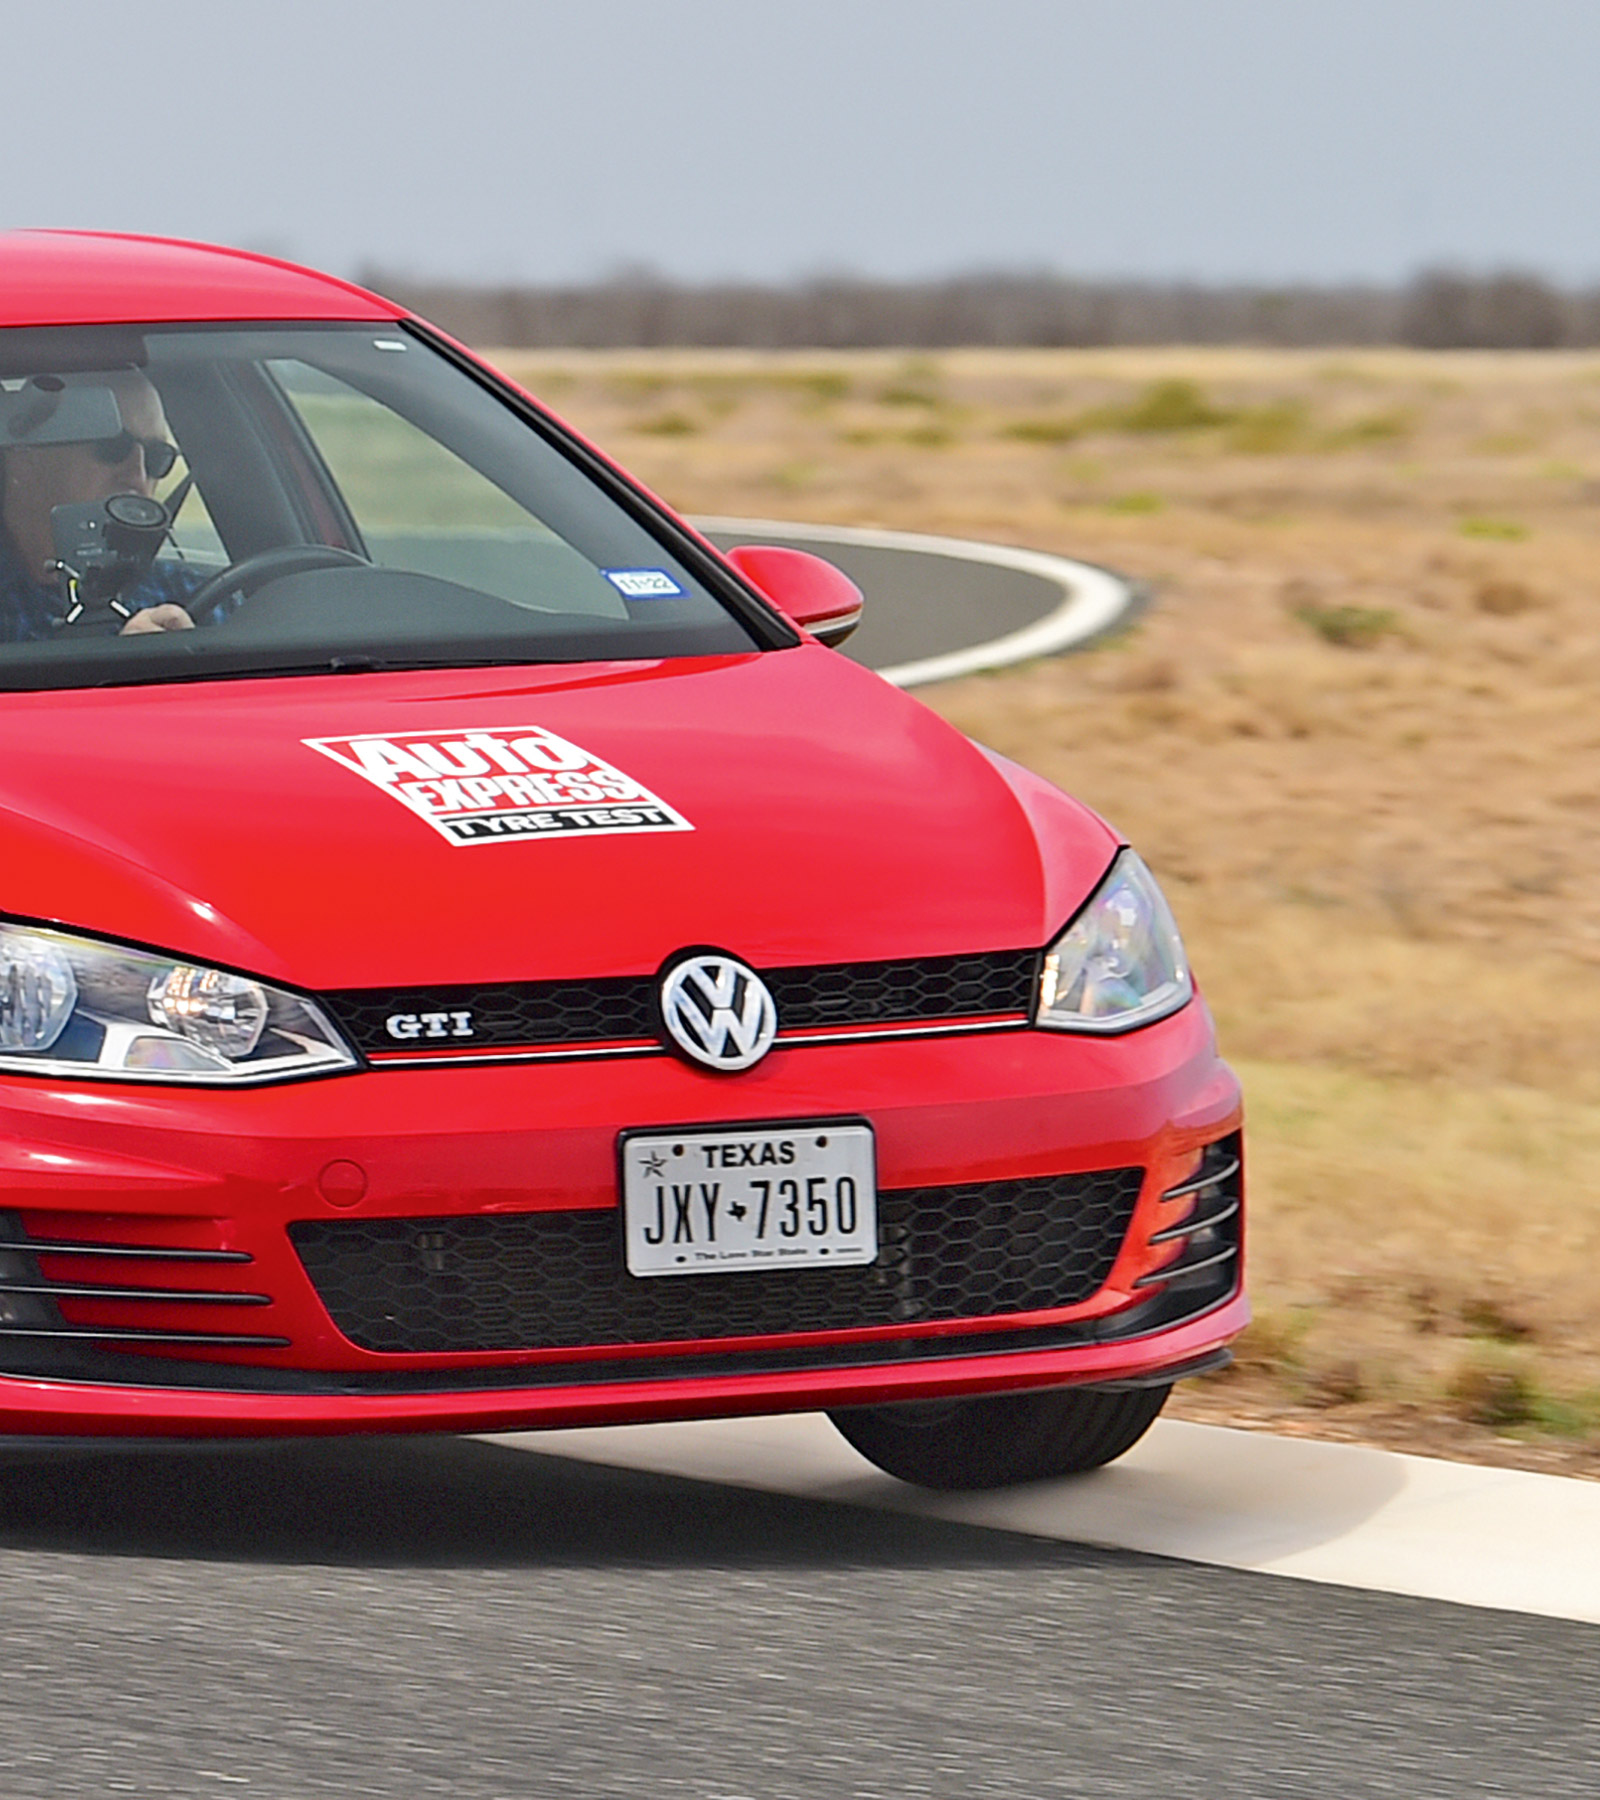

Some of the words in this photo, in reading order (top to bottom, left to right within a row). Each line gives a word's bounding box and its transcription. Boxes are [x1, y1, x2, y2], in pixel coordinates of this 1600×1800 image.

[349, 733, 592, 782] Auto
[399, 769, 639, 812] EXPRESS
[446, 813, 562, 837] TYRE
[561, 808, 667, 827] TEST
[386, 1011, 474, 1039] GTI
[702, 1141, 795, 1169] TEXAS
[643, 1182, 721, 1244] JXY
[749, 1176, 856, 1240] 7350
